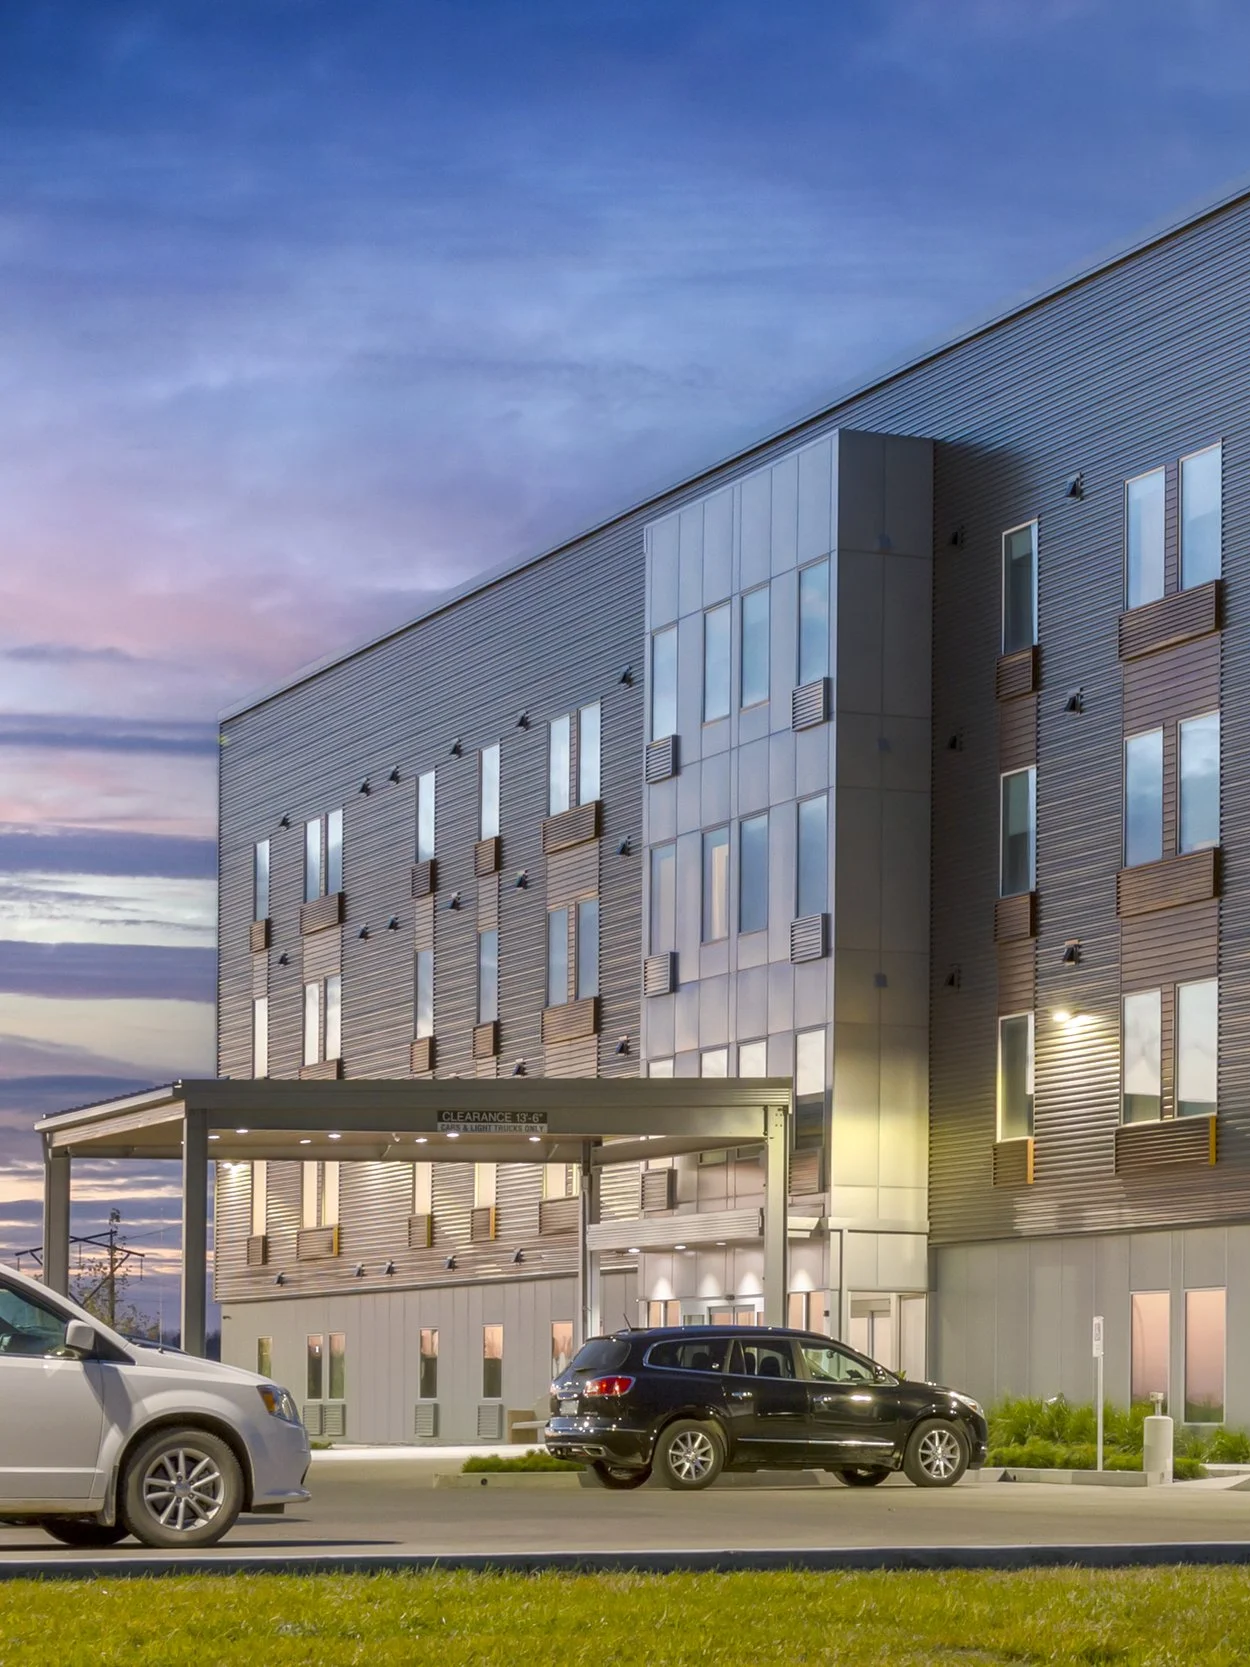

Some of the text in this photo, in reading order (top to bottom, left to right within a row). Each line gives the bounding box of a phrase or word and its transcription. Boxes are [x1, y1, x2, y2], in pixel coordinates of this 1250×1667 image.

[442, 1111, 512, 1122] CLEARANCE
[470, 1124, 492, 1132] LIGHT
[524, 1125, 544, 1133] ONLY
